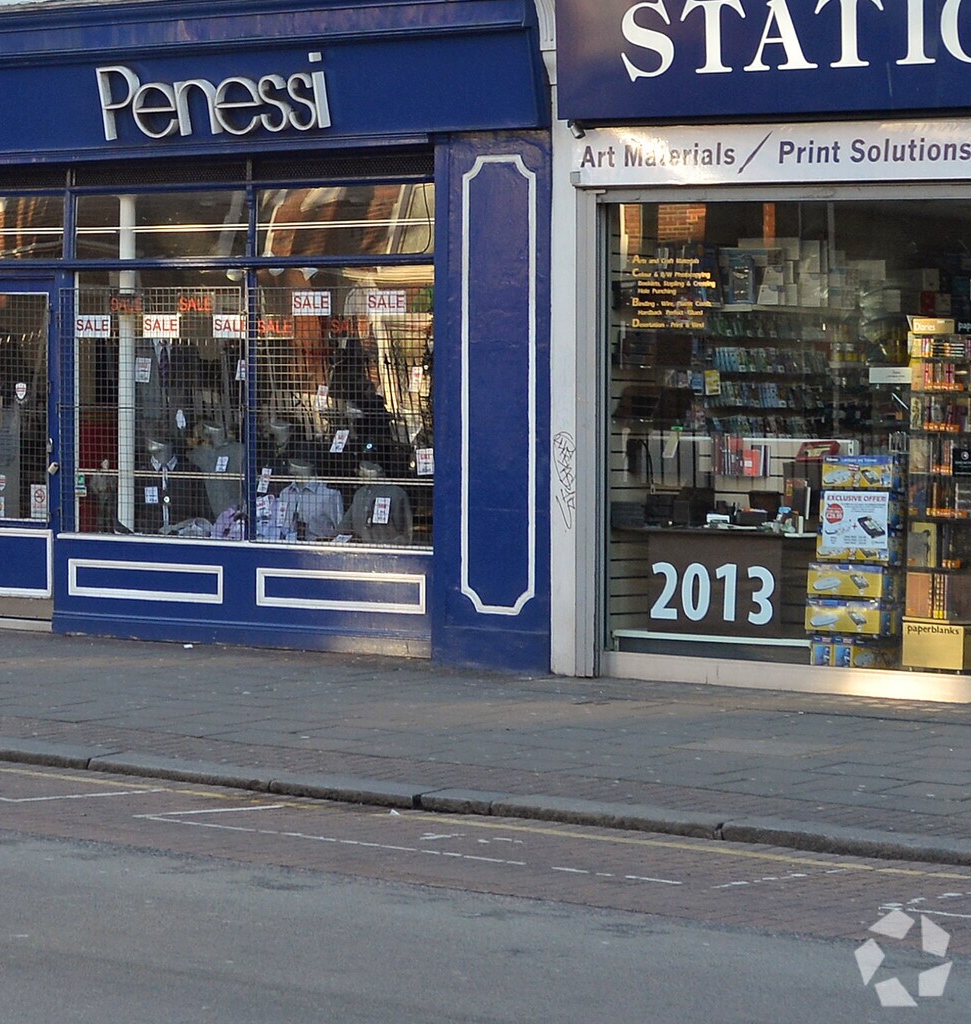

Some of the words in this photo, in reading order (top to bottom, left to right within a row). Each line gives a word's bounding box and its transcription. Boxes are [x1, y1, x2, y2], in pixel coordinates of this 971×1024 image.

[95, 51, 331, 141] Penessi
[581, 145, 615, 169] Art
[624, 141, 736, 167] Materials
[779, 138, 841, 165] Print
[850, 136, 971, 164] Solutions
[180, 296, 213, 312] SALE
[293, 295, 329, 309] SALE
[368, 295, 405, 309] SALE
[76, 319, 109, 332] SALE
[144, 319, 178, 332] SALE
[214, 318, 247, 332] SALE
[258, 319, 293, 334] SALE
[650, 561, 775, 625] 2013
[907, 625, 960, 635] paperblanks
